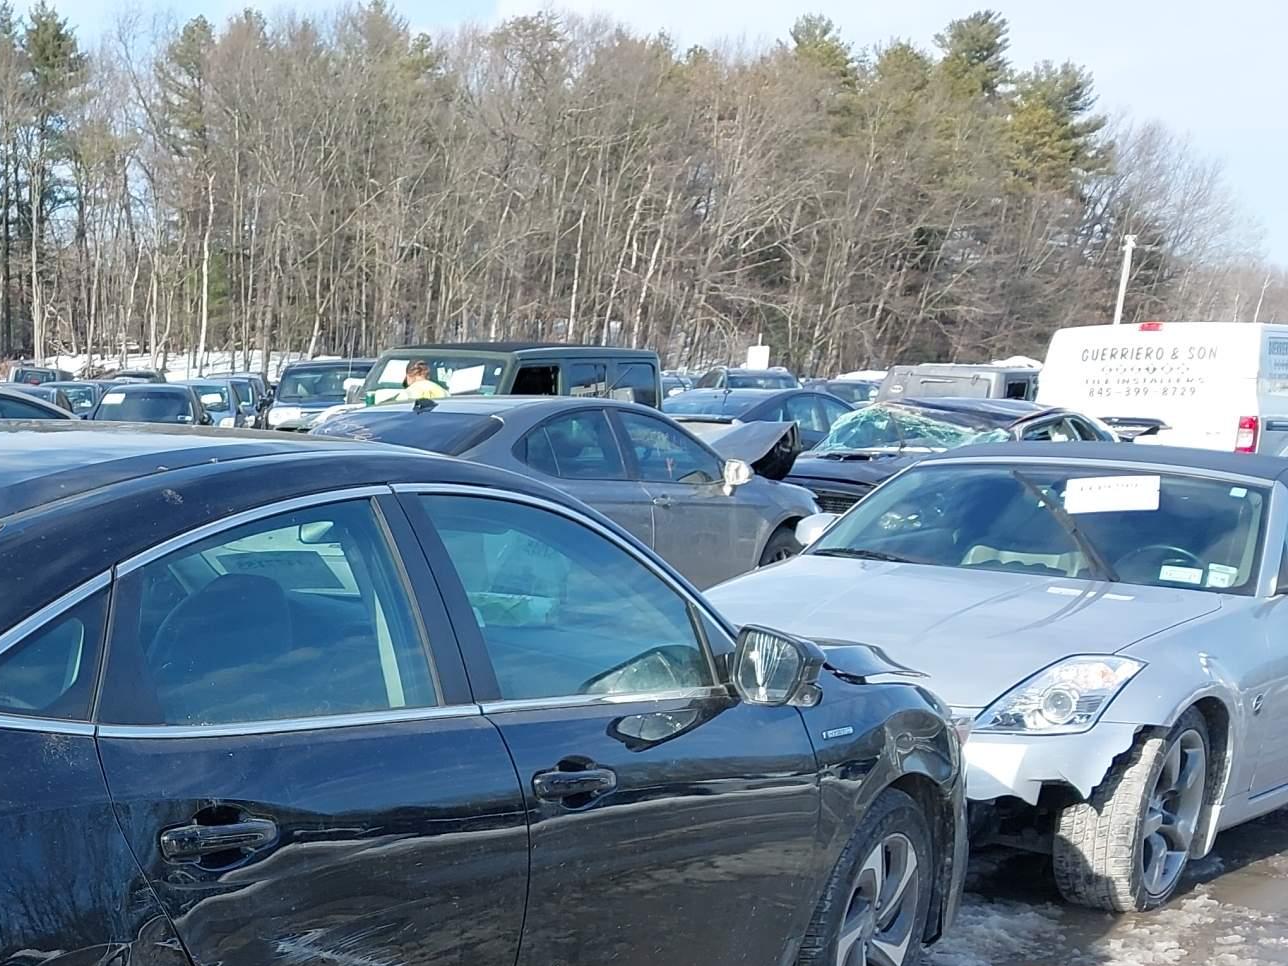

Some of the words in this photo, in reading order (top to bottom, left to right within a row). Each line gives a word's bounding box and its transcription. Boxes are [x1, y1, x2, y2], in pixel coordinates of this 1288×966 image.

[1081, 347, 1164, 362] GUERRIERO
[1170, 348, 1179, 360] &
[1187, 346, 1218, 360] SON
[1088, 386, 1196, 398] 845-399-8729
